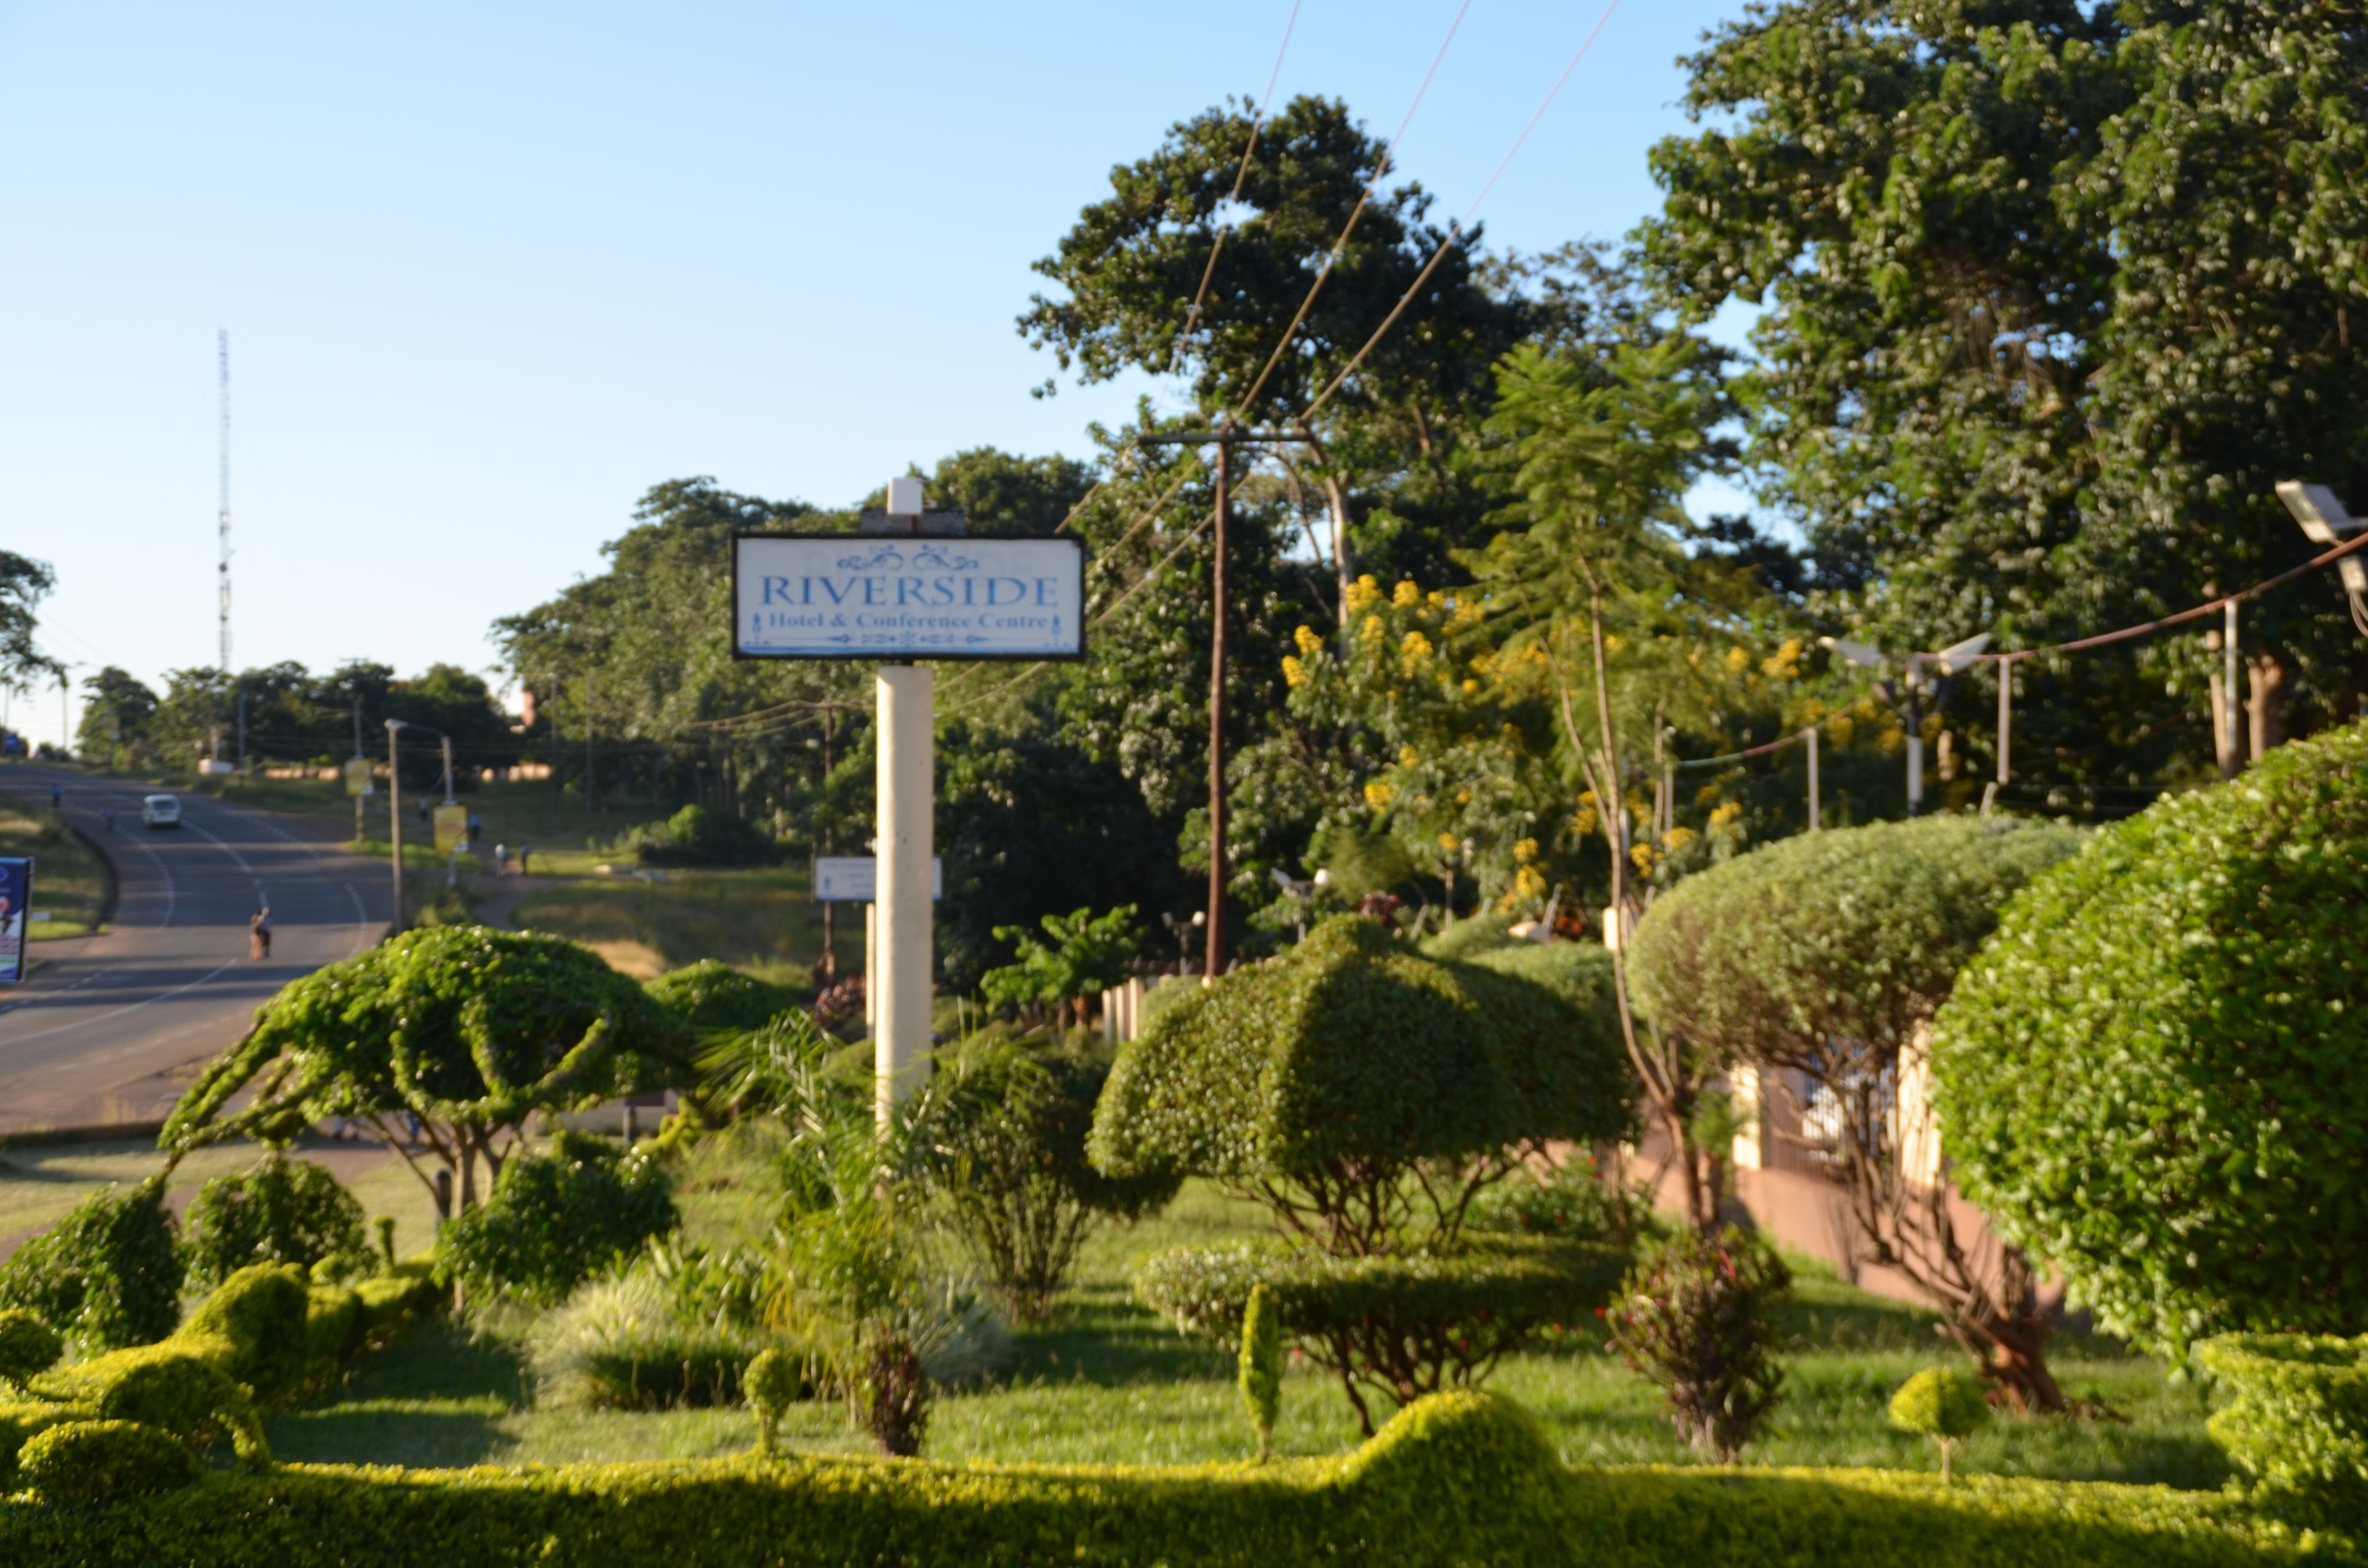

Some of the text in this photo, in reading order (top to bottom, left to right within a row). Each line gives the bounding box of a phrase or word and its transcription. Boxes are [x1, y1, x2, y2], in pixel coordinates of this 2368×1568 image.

[759, 575, 1058, 607] RIVERSIDE
[769, 612, 1047, 628] Hotel & Conference Centre
